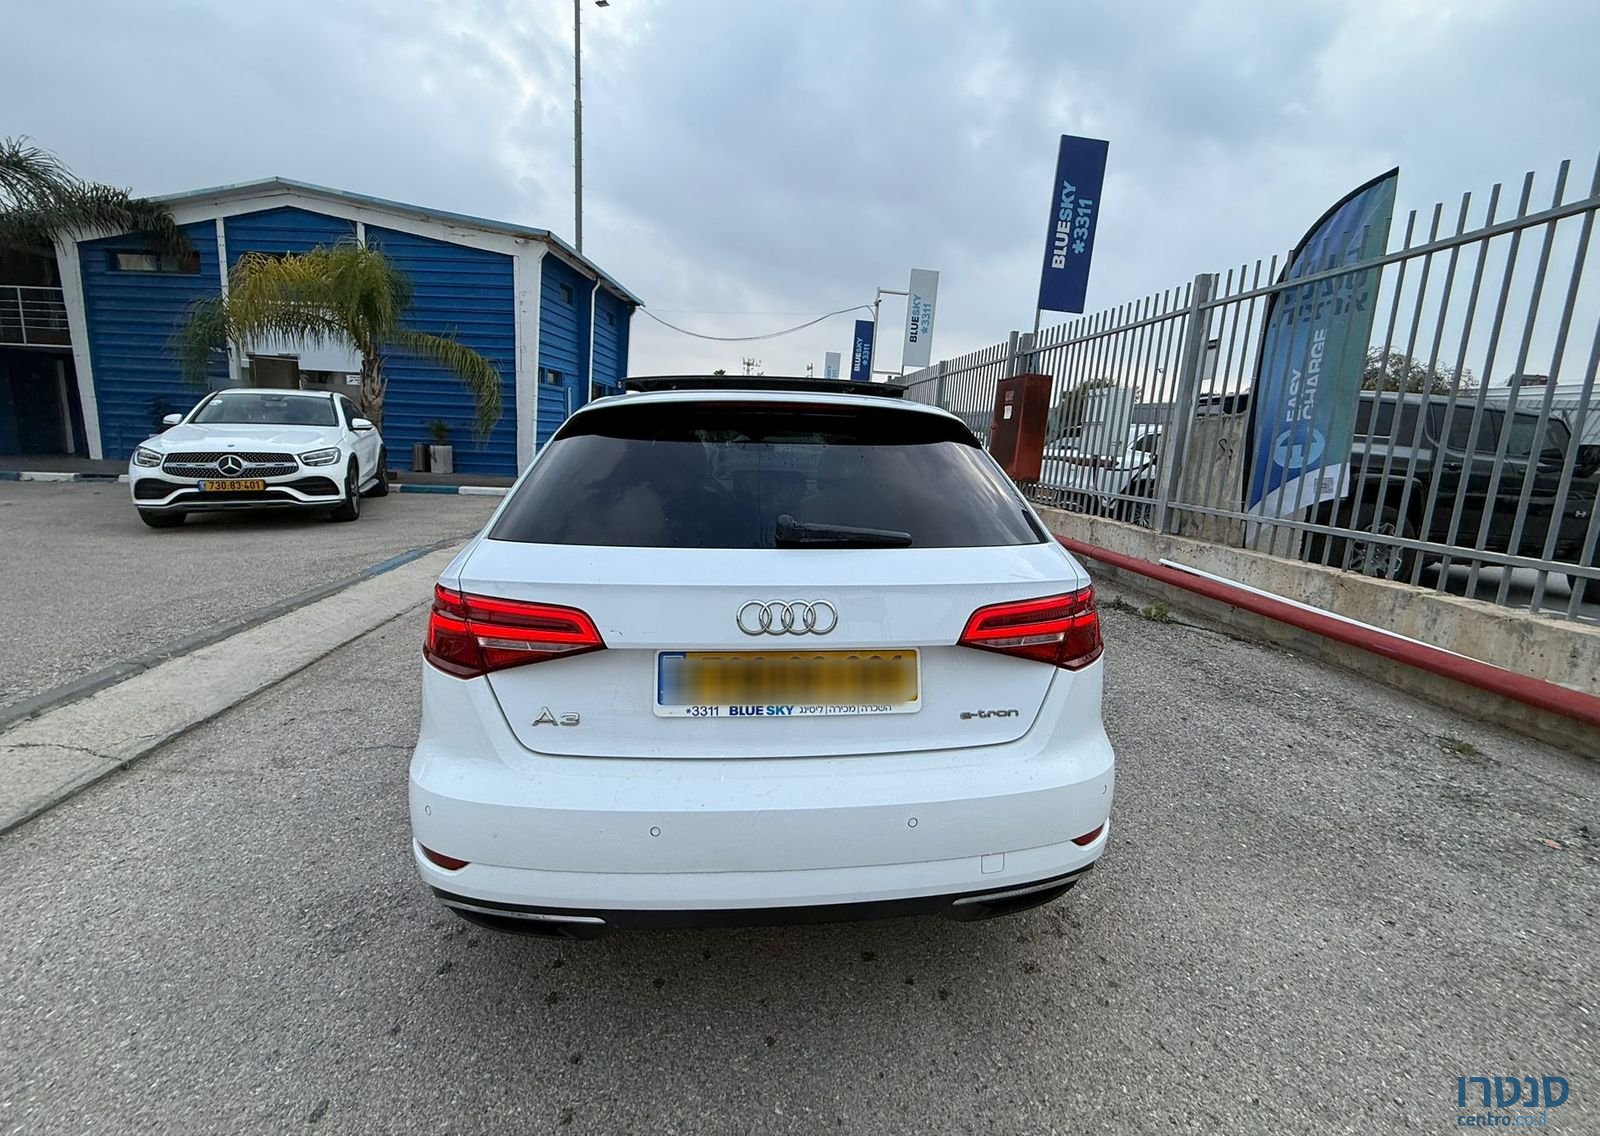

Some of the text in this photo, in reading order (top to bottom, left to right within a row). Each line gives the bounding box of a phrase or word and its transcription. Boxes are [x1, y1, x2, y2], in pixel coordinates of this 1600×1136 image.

[1302, 327, 1327, 420] CHARGE
[531, 706, 580, 727] A3
[960, 709, 1019, 720] e-tron
